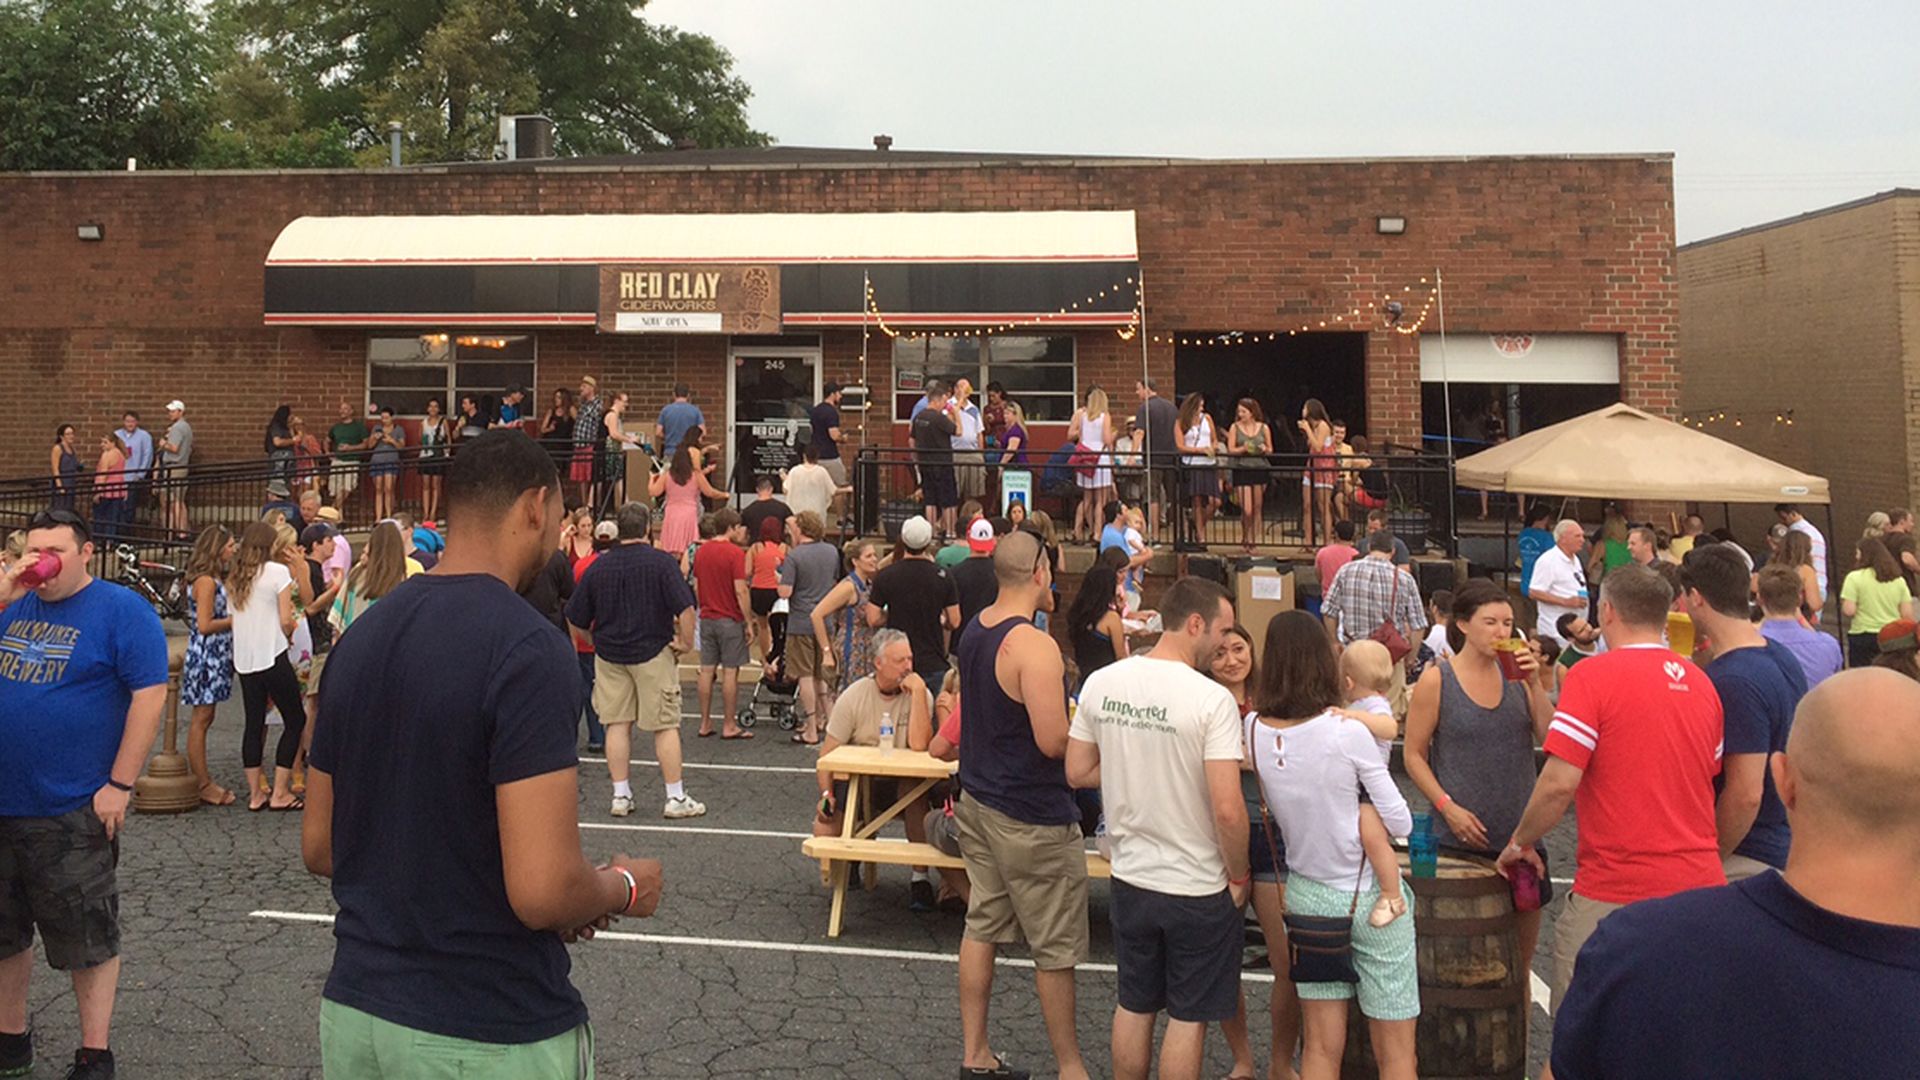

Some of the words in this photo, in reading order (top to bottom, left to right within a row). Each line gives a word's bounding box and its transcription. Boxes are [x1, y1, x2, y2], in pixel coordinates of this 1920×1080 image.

[620, 271, 662, 298] RED
[668, 272, 721, 299] CLAY
[620, 300, 716, 311] CIDERWORKS
[641, 317, 663, 326] NOW
[665, 317, 689, 327] OPEN
[765, 359, 785, 370] 245
[752, 426, 767, 436] RED
[768, 426, 785, 436] CLAY
[5, 619, 81, 645] MILWAUKEE
